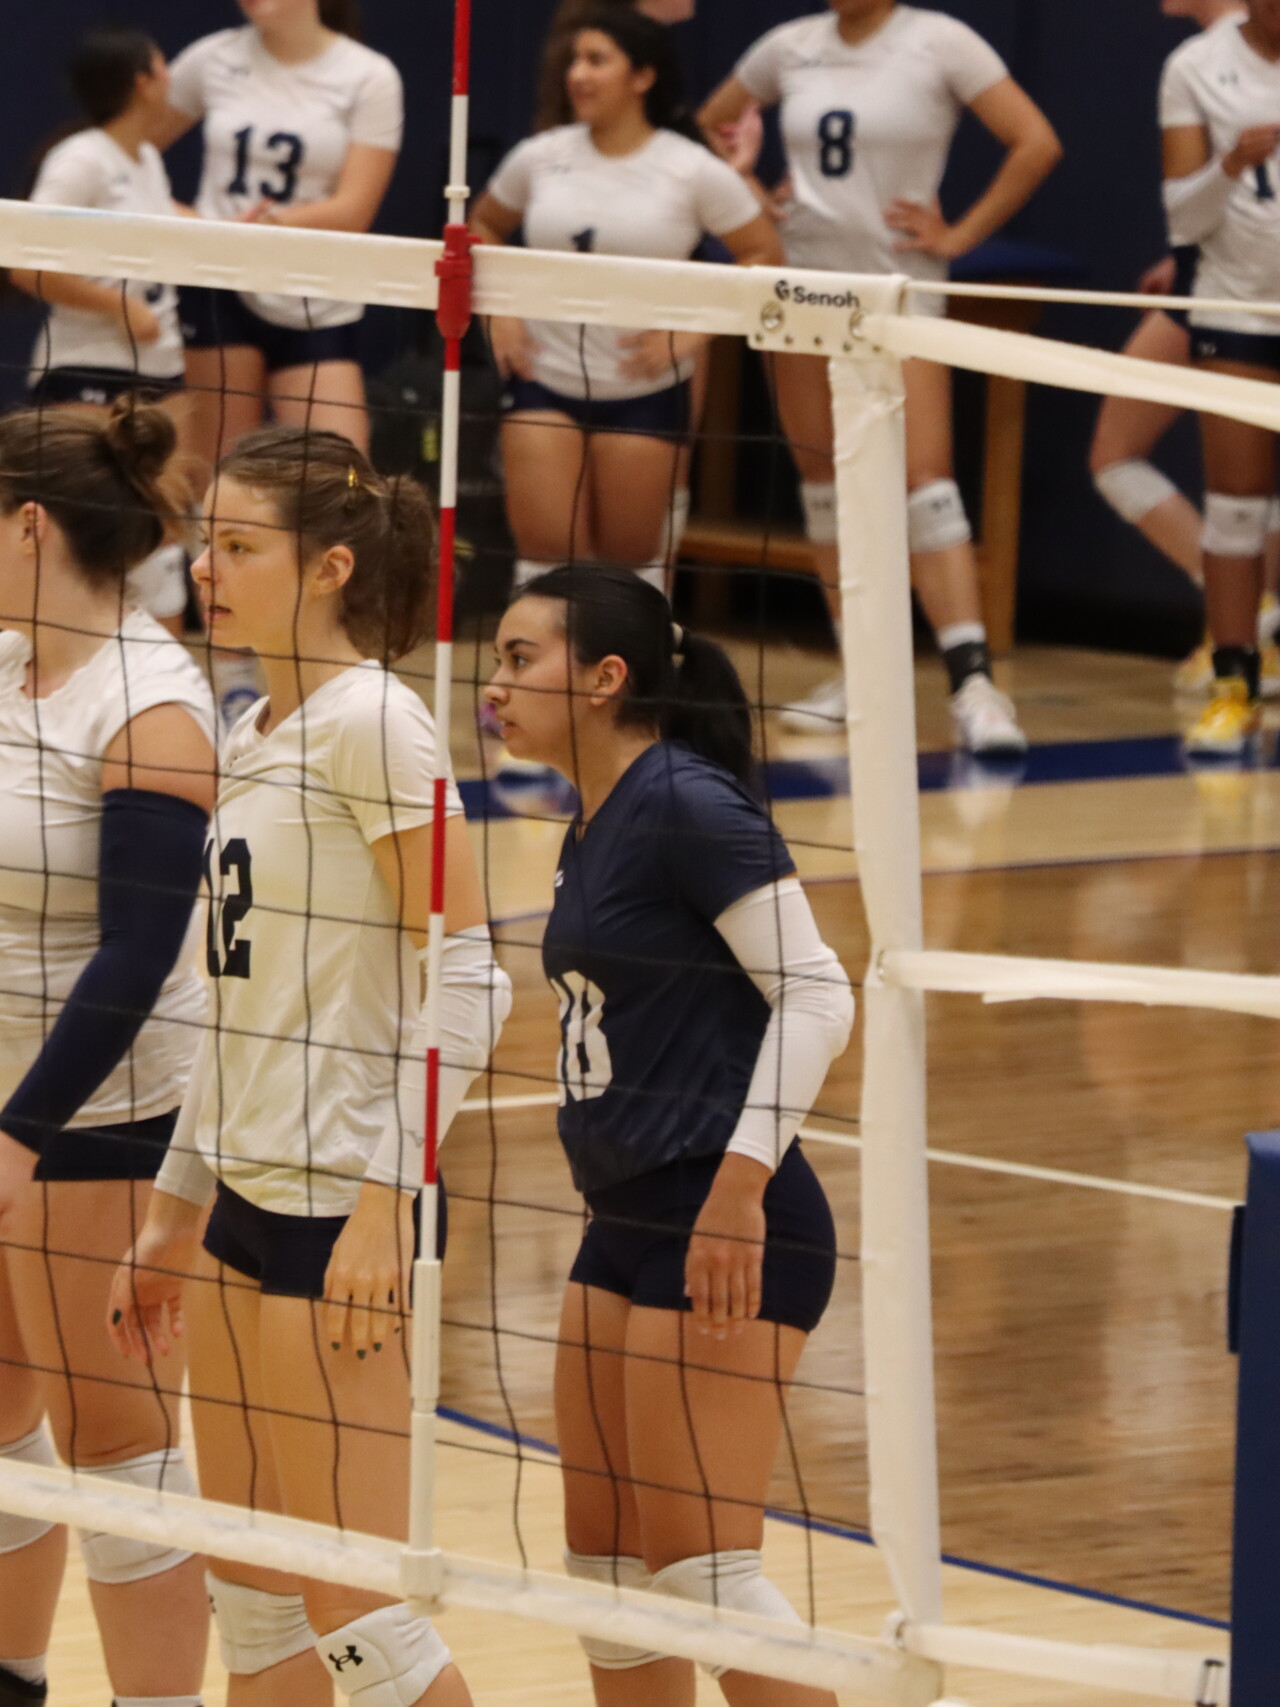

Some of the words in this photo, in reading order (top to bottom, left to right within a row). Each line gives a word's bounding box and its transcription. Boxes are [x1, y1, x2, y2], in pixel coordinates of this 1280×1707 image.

[227, 126, 304, 201] 13
[818, 110, 854, 177] 8
[793, 286, 860, 308] Senoh
